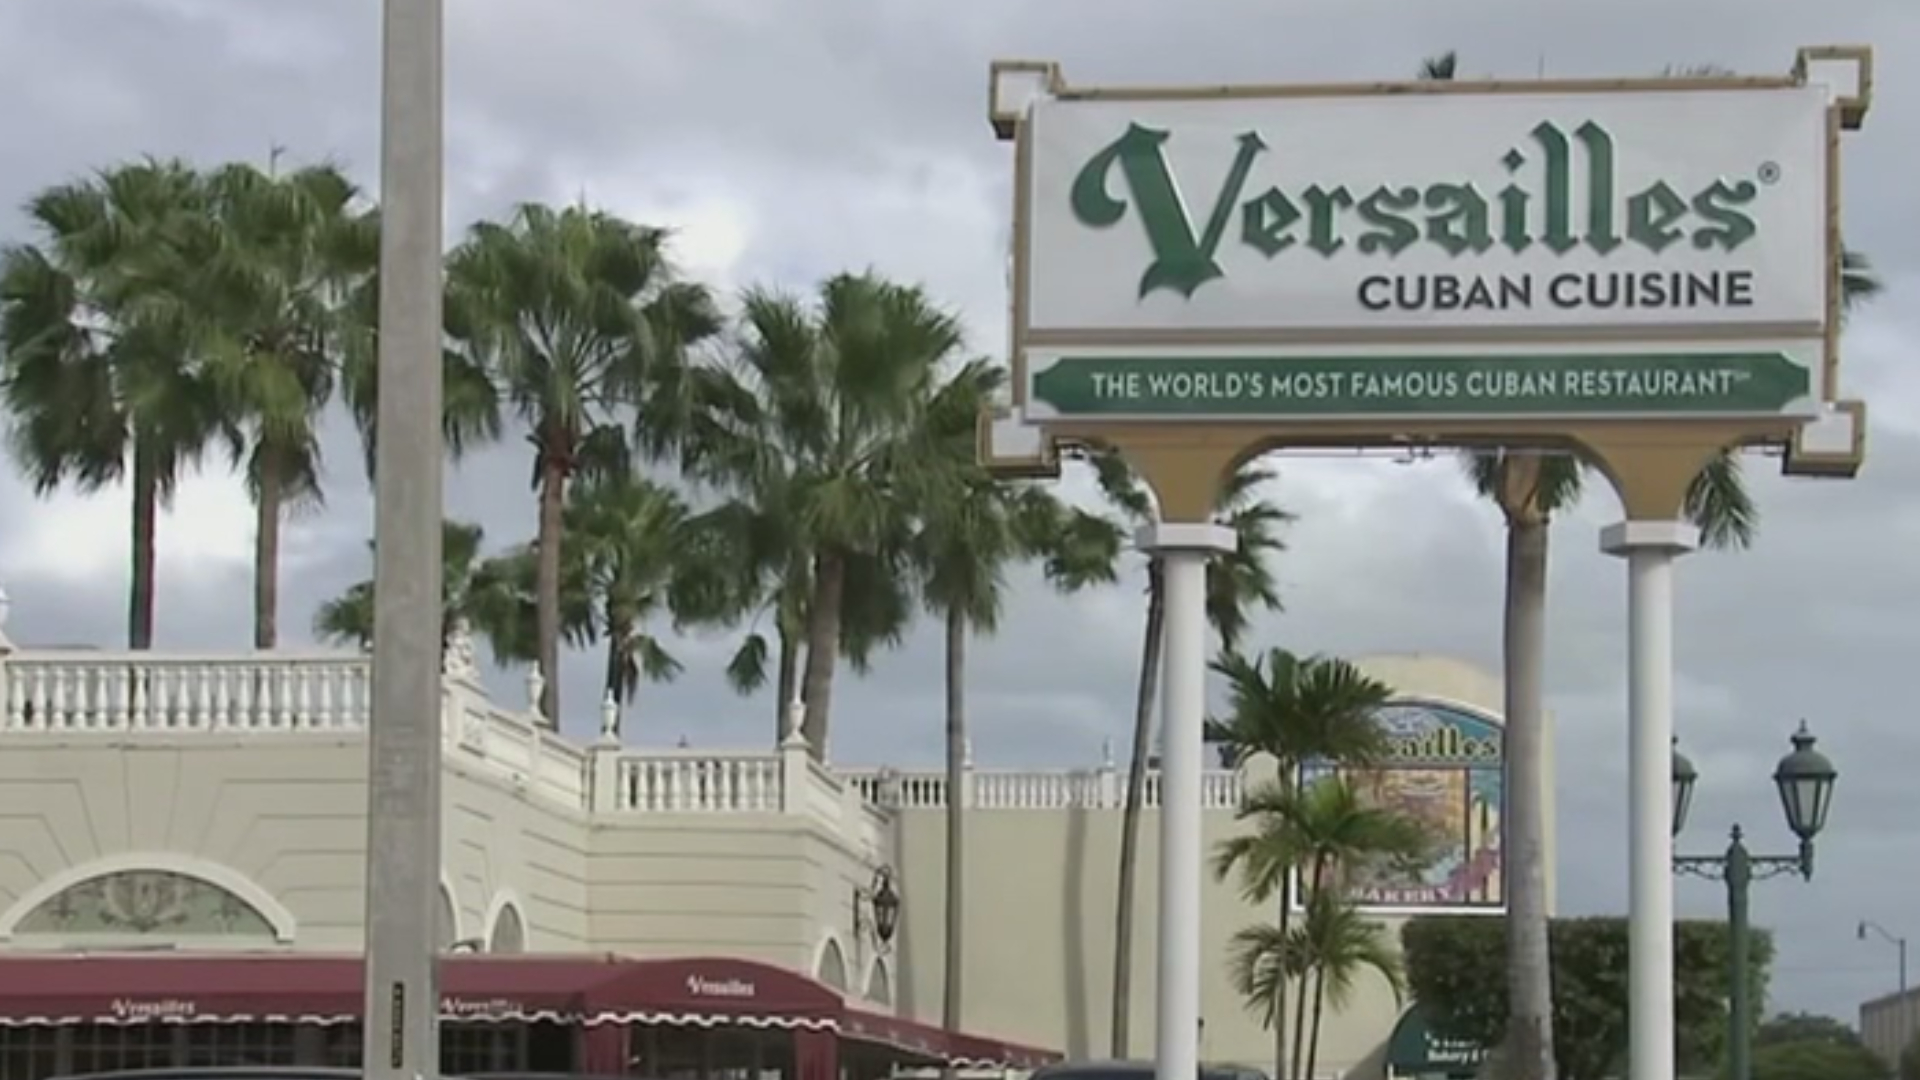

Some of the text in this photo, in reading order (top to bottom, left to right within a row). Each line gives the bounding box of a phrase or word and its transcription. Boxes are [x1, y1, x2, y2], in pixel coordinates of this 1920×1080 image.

[1357, 270, 1754, 312] CUBAN CUISINE
[1091, 373, 1140, 398] THE
[1149, 373, 1264, 398] WORLD'S
[1271, 373, 1343, 398] MOST
[1351, 372, 1458, 397] FAMOUS
[1466, 371, 1556, 397] CUBAN
